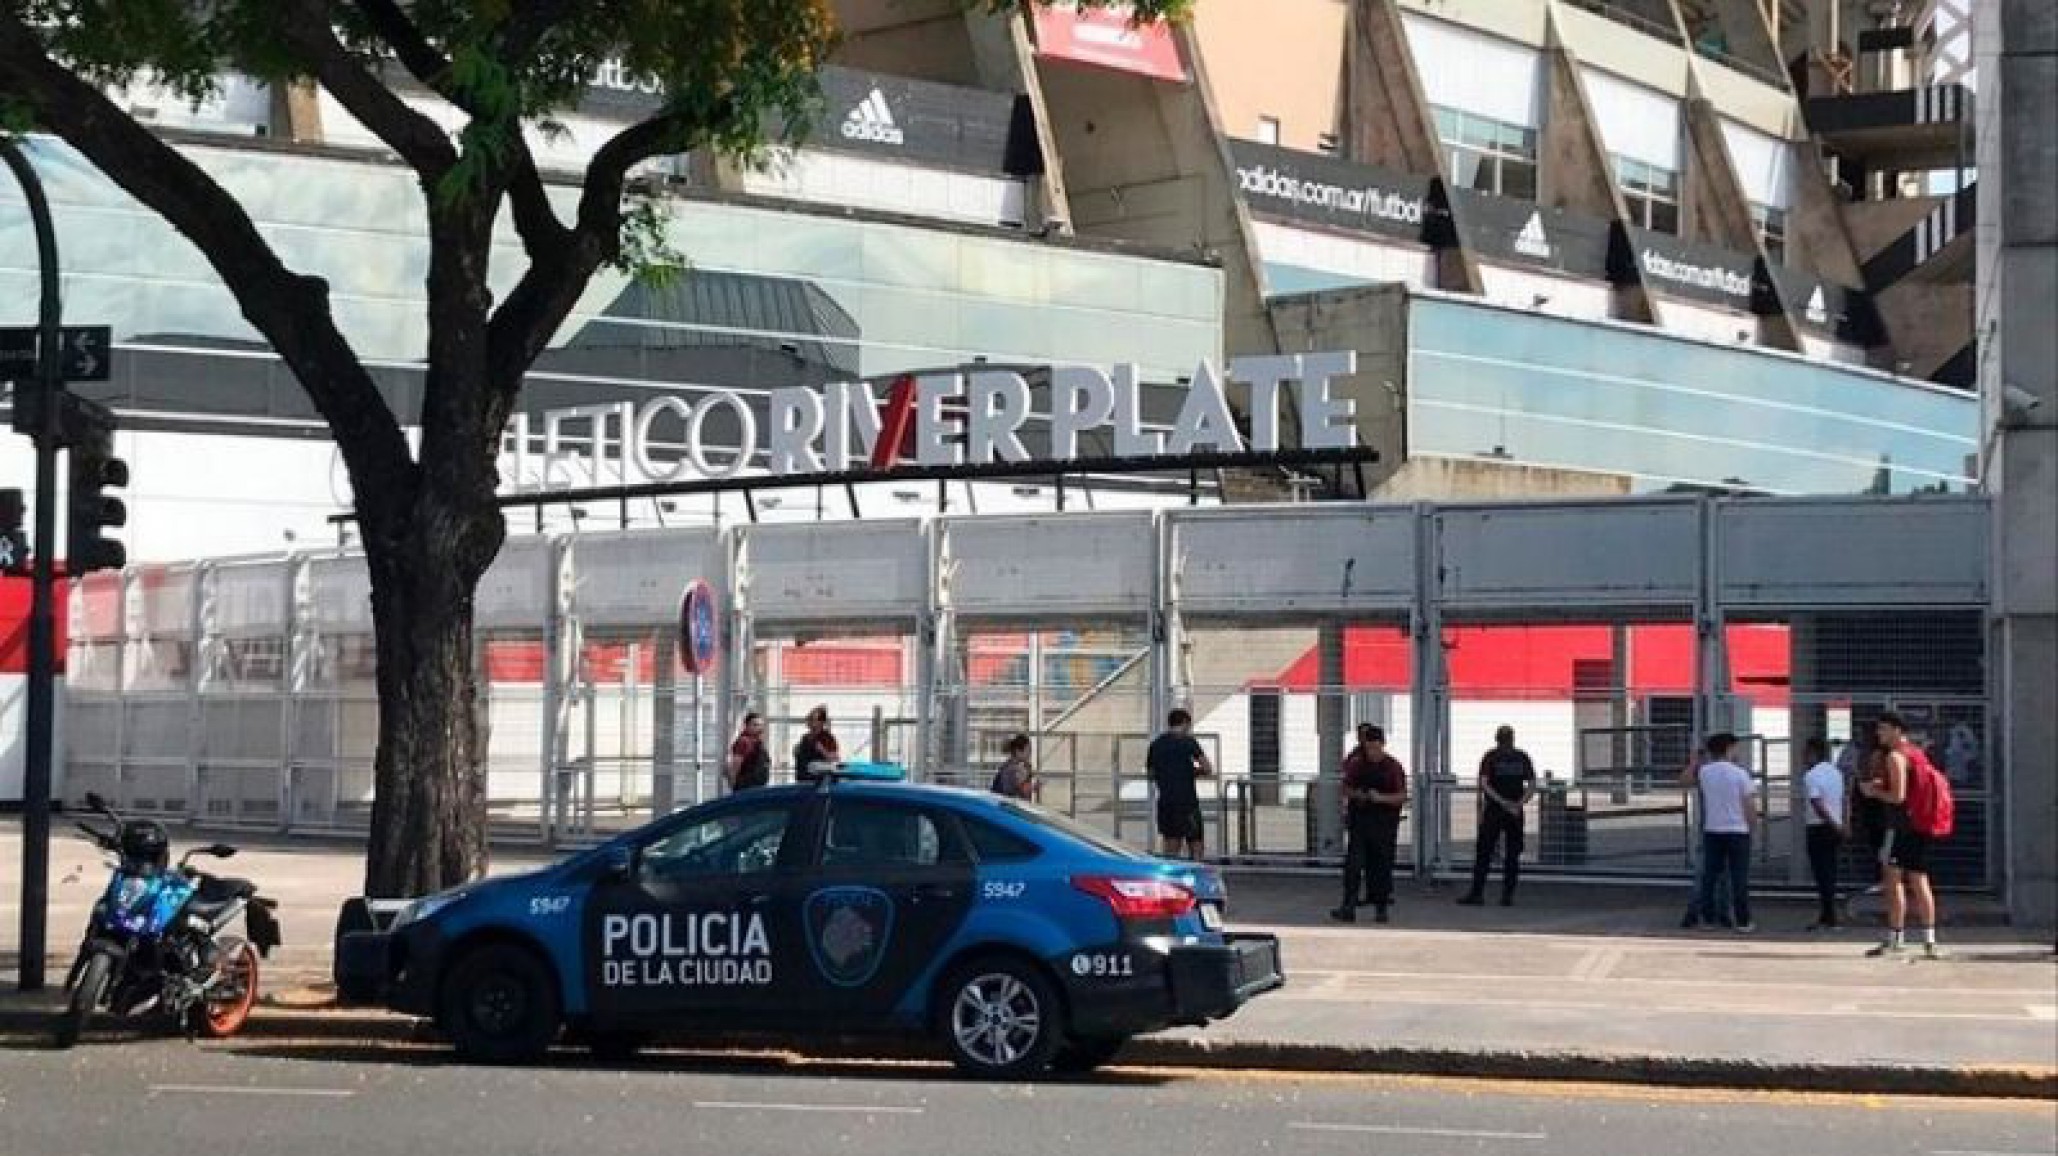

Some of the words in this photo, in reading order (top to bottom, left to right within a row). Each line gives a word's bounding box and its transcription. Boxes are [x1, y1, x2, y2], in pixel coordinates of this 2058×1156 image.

[841, 121, 904, 145] adidas
[508, 391, 757, 491] LETICO
[770, 370, 1033, 475] RIVER
[1051, 349, 1357, 461] PLATE
[603, 912, 770, 956] POLICIA
[603, 959, 637, 985] DE
[642, 959, 674, 985] LA
[678, 959, 773, 985] CIUDAD
[1092, 953, 1133, 977] 911
